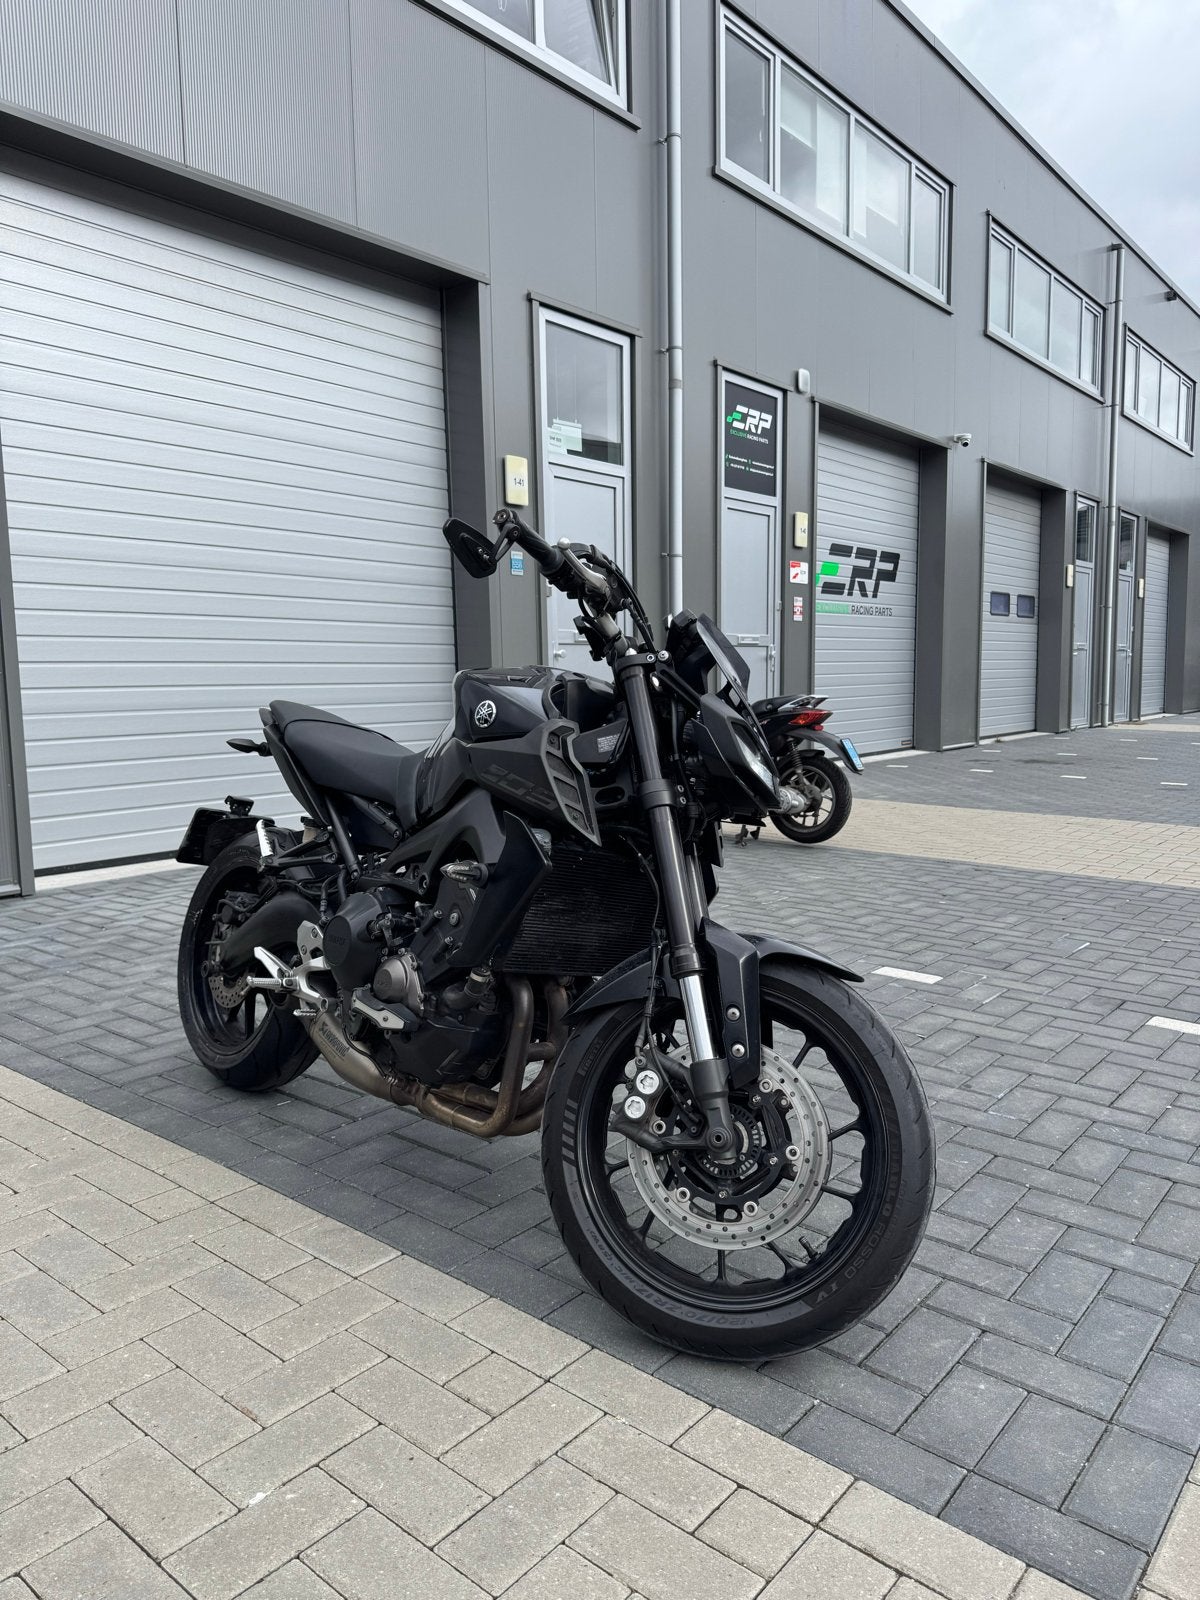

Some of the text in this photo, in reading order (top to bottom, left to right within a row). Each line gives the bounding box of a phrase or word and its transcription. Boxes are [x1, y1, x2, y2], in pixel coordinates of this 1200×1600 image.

[726, 404, 773, 435] ERP
[816, 543, 900, 599] ERP
[851, 604, 874, 616] RACING
[874, 606, 893, 617] PARTS
[844, 1222, 887, 1280] ROSSO
